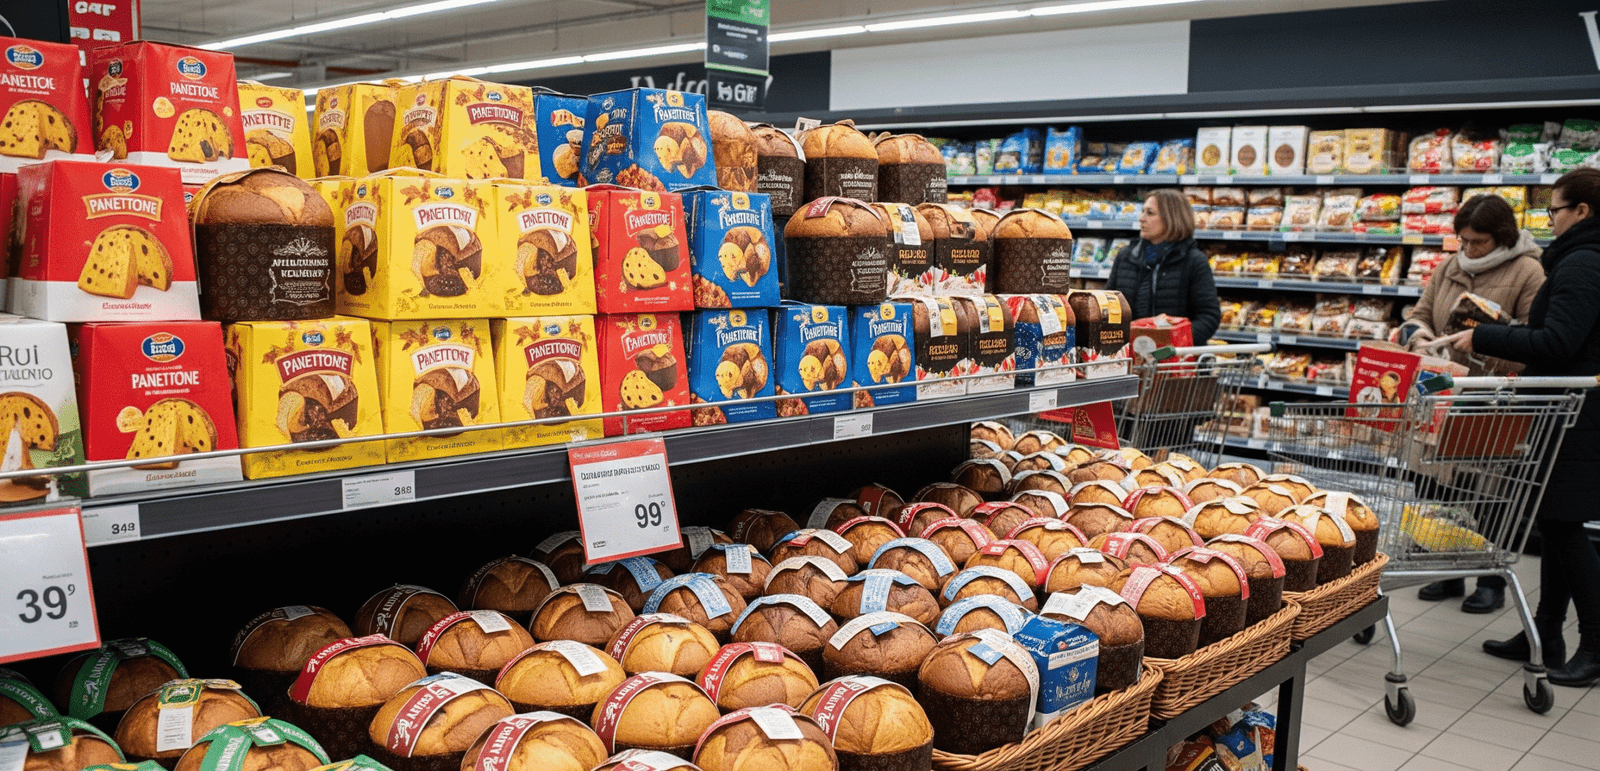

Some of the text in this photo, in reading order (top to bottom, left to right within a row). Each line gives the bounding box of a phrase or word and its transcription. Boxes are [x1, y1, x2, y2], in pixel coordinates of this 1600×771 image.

[89, 197, 157, 215] PANETTONE
[131, 370, 200, 389] PANETTONE
[634, 501, 662, 529] 99
[16, 585, 68, 624] 39
